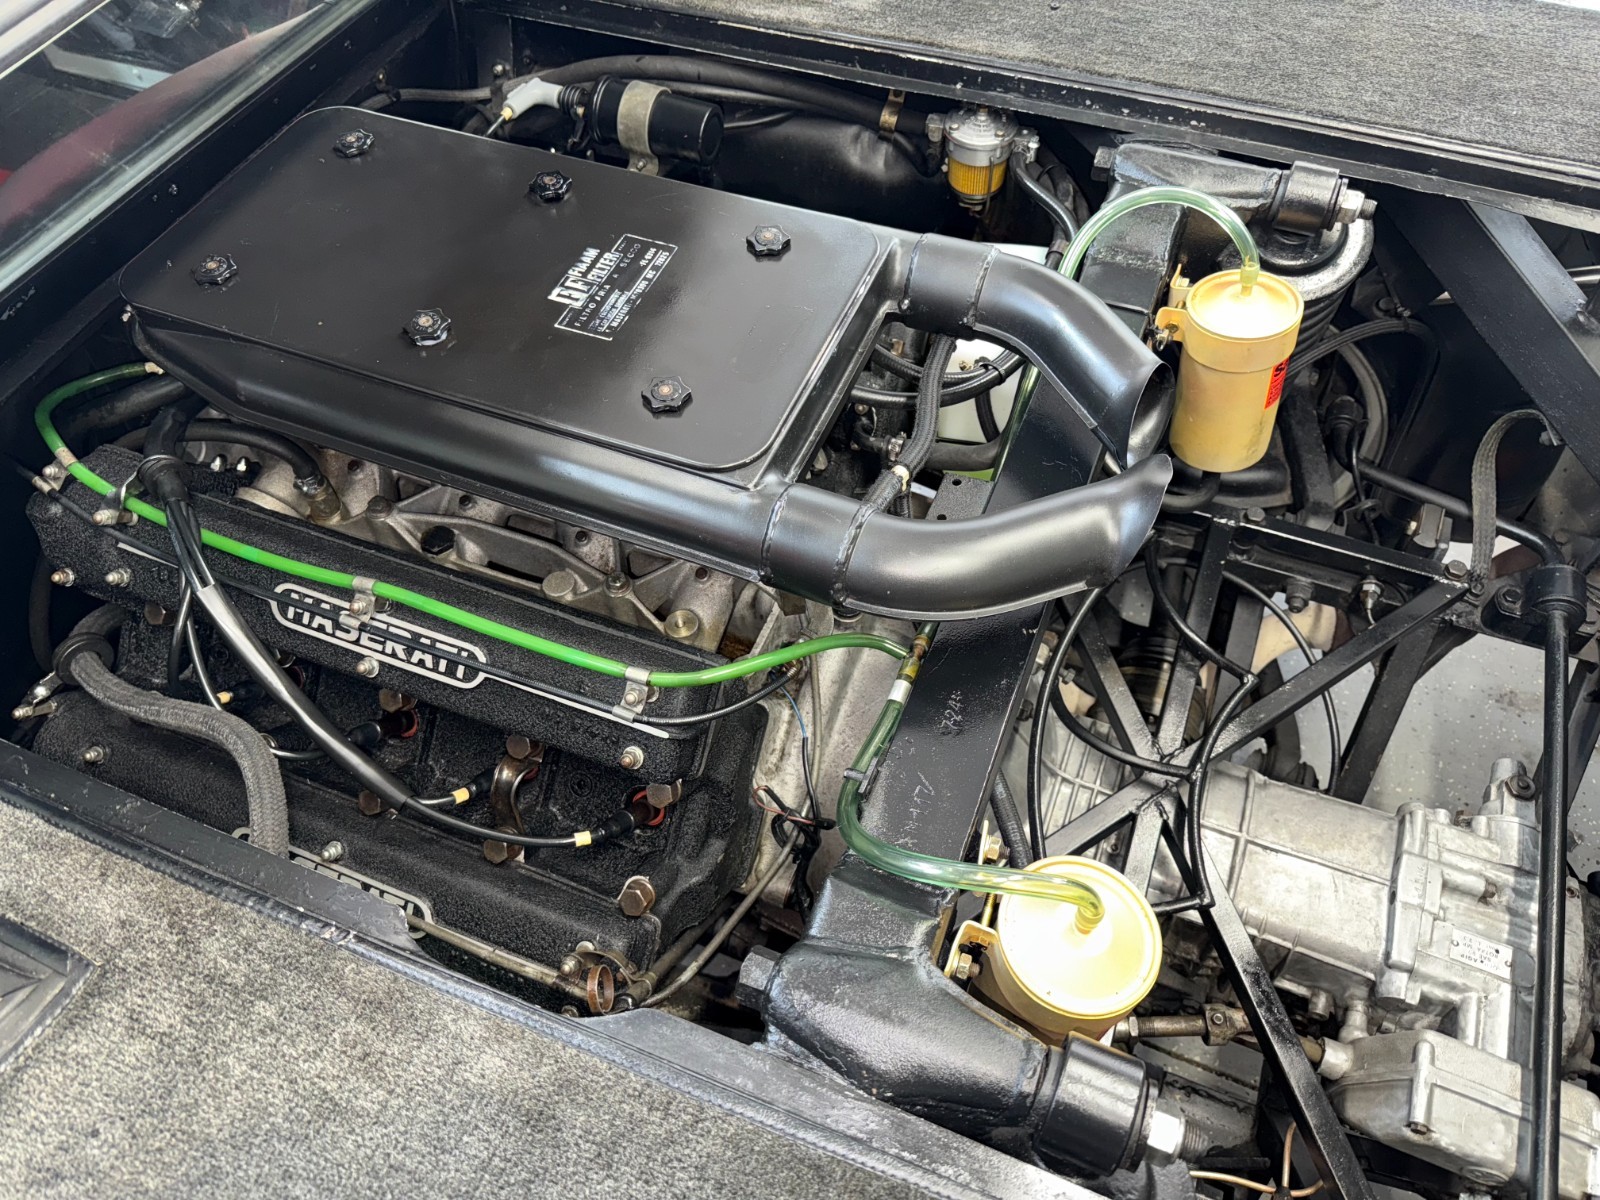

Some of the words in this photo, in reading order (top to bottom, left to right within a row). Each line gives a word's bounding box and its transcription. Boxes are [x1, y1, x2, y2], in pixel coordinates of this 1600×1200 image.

[566, 247, 601, 276] FIAAM
[586, 251, 619, 281] FILTER
[573, 302, 597, 326] FILTRO
[593, 284, 611, 300] ARIA
[618, 243, 641, 267] SECCO
[287, 592, 469, 680] MASERATI
[1460, 952, 1477, 963] AGIP
